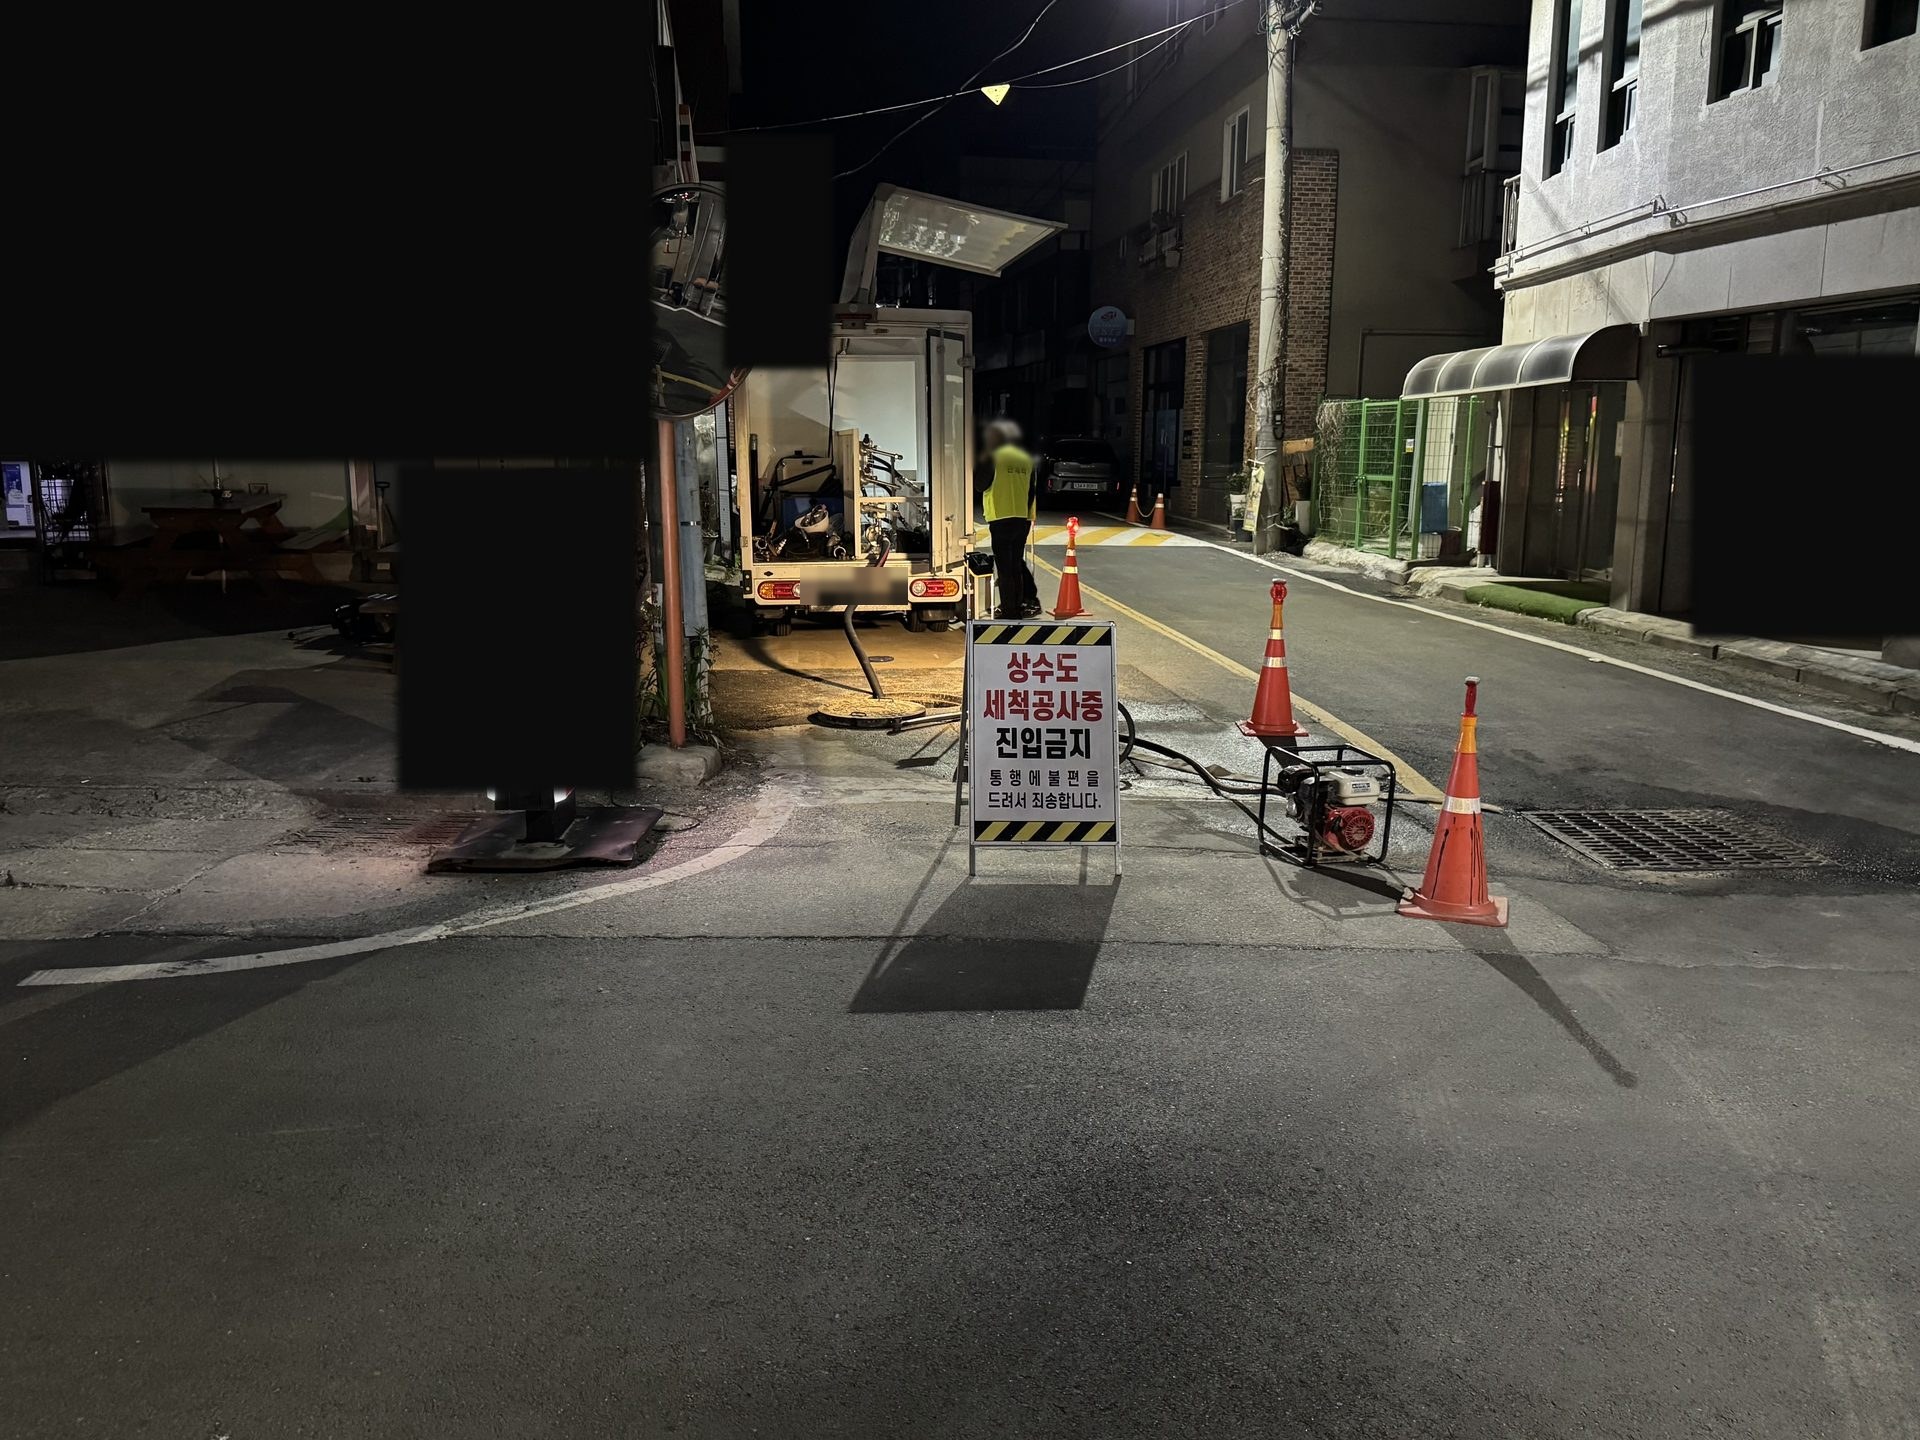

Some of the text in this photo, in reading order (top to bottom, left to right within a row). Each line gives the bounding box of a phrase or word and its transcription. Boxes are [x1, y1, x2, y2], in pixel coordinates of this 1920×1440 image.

[1007, 652, 1079, 683] 상수도
[983, 689, 1103, 722] 세척공사중
[996, 727, 1091, 759] 진입금지
[988, 791, 1101, 809] 드려서 죄송합니다.
